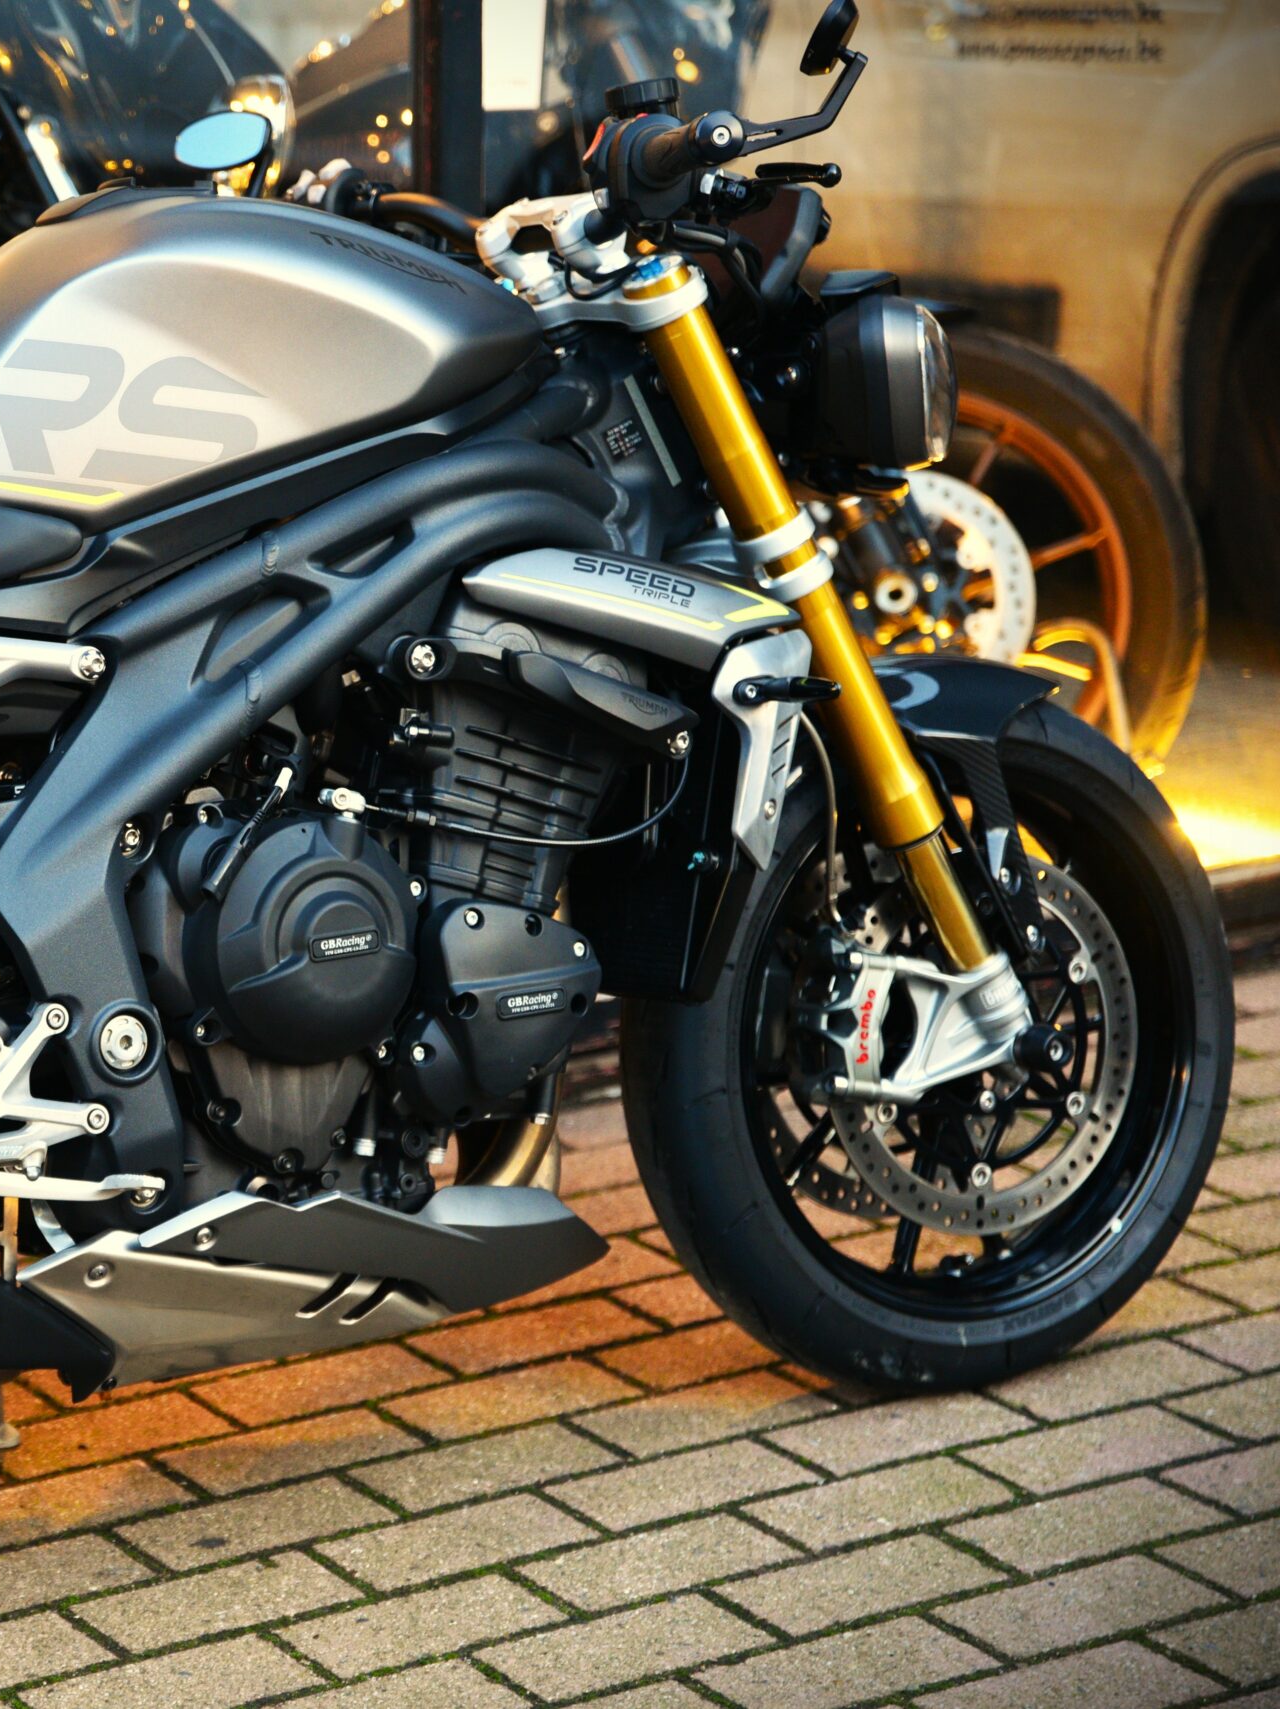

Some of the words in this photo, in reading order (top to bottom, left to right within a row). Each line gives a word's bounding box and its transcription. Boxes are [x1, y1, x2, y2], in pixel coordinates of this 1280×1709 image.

[310, 231, 467, 295] TRIUMPH
[573, 556, 696, 598] SPEED
[631, 585, 692, 609] TRIPLE
[855, 989, 876, 1064] brembo
